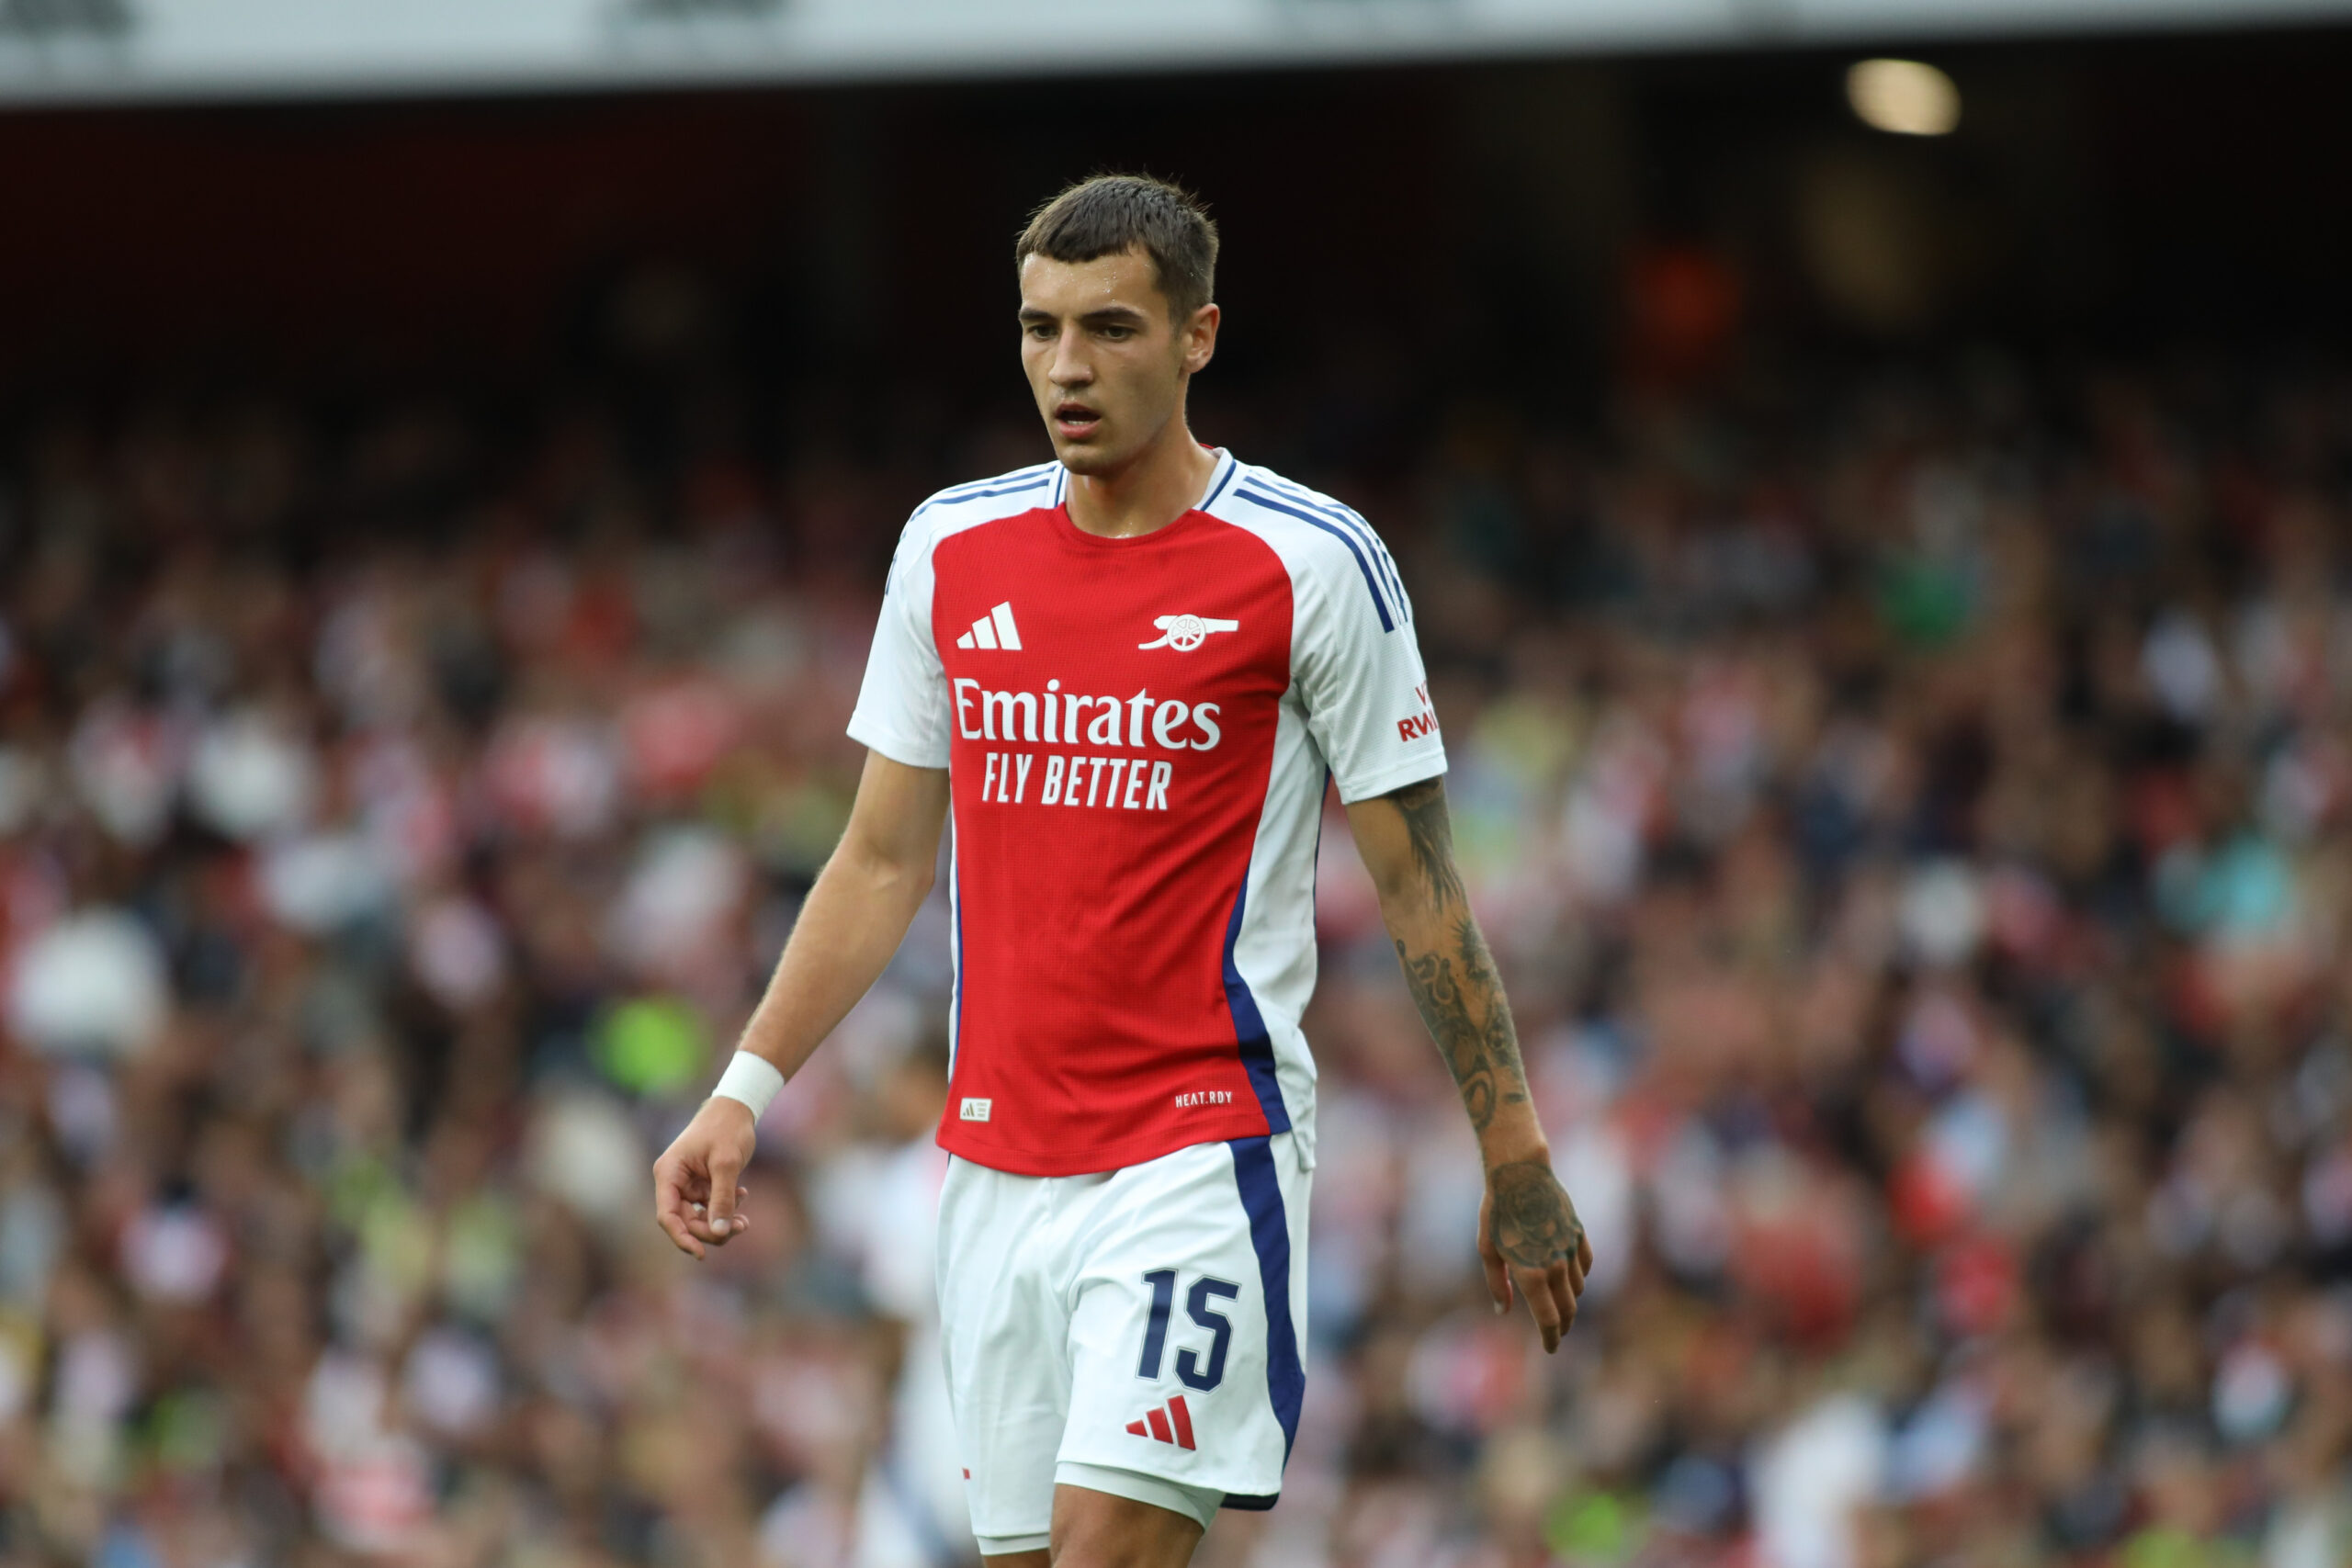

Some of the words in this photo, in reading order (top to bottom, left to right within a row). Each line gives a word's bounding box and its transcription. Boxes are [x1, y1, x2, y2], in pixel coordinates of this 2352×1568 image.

[953, 678, 1221, 751] Emirates
[982, 752, 1034, 804] FLY
[1041, 755, 1173, 810] BETTER
[1175, 1090, 1233, 1109] HEAT.RDY
[1135, 1267, 1242, 1394] 15
